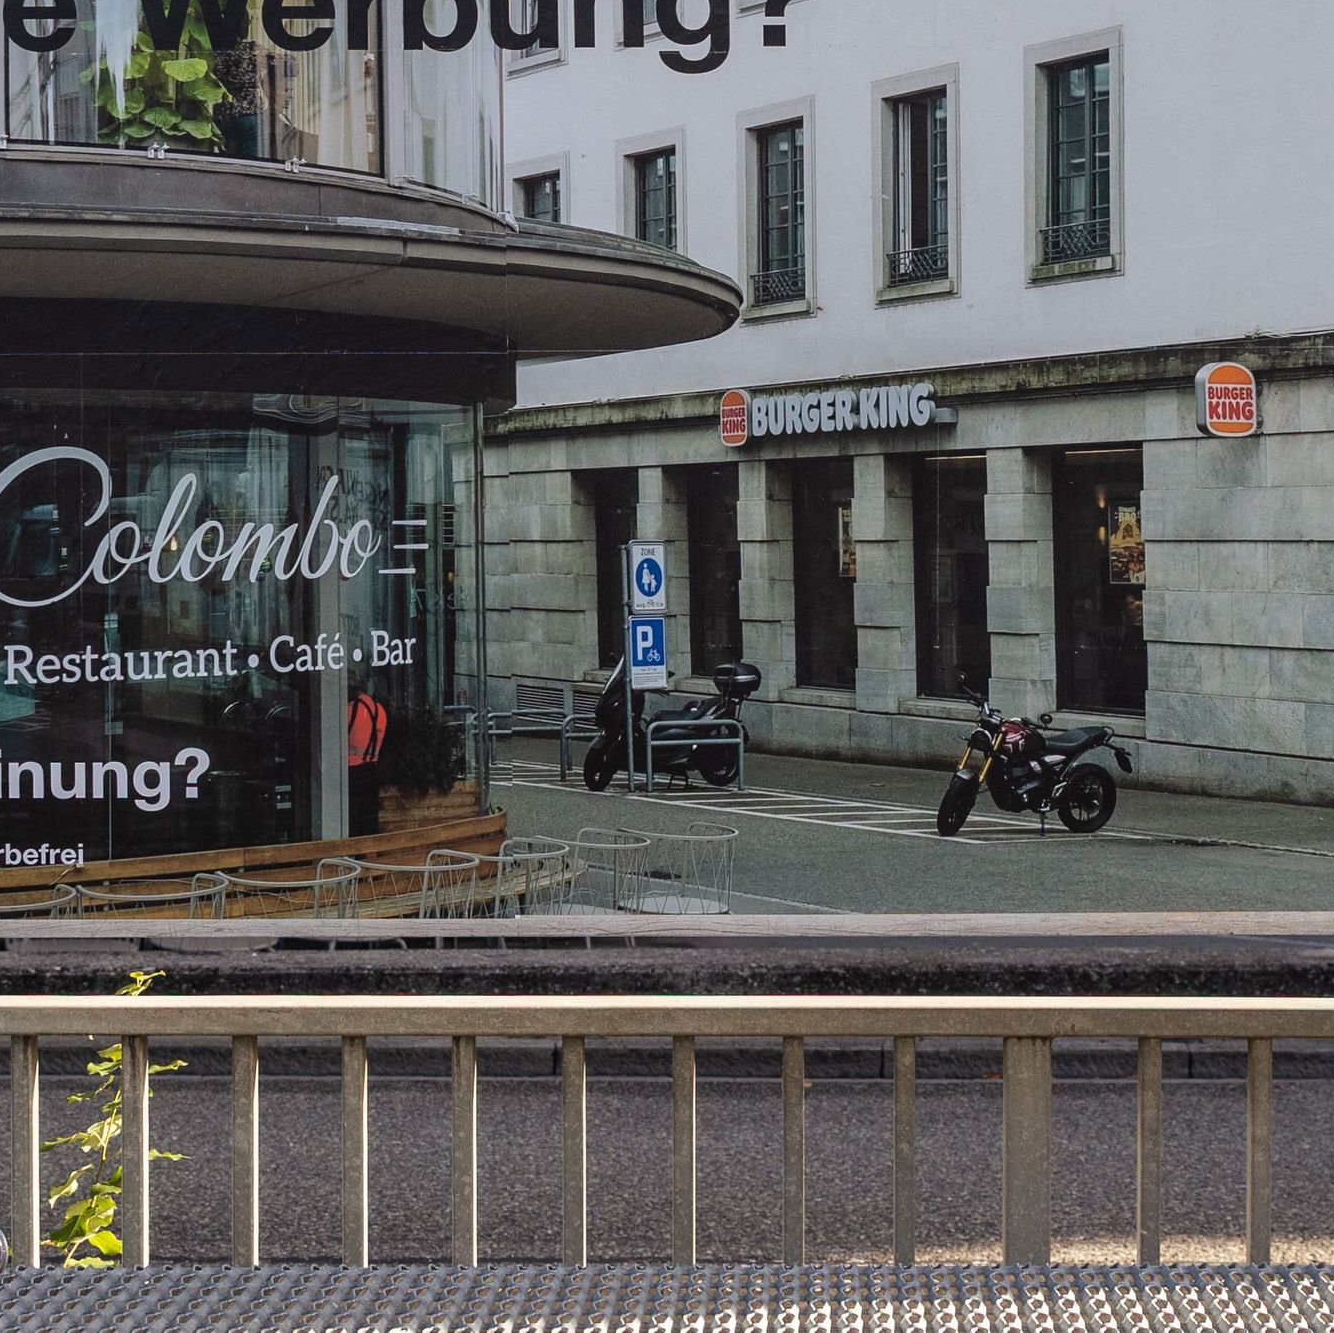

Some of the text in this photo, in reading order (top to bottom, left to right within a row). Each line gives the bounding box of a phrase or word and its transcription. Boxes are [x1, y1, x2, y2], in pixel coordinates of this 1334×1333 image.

[1208, 386, 1253, 400] BURGER
[722, 407, 745, 418] BURGER
[752, 383, 932, 437] BURGER KING
[1208, 400, 1254, 420] KING
[722, 418, 745, 434] KING
[640, 548, 656, 556] ZONE
[4, 630, 416, 686] Restaurant Café Bar
